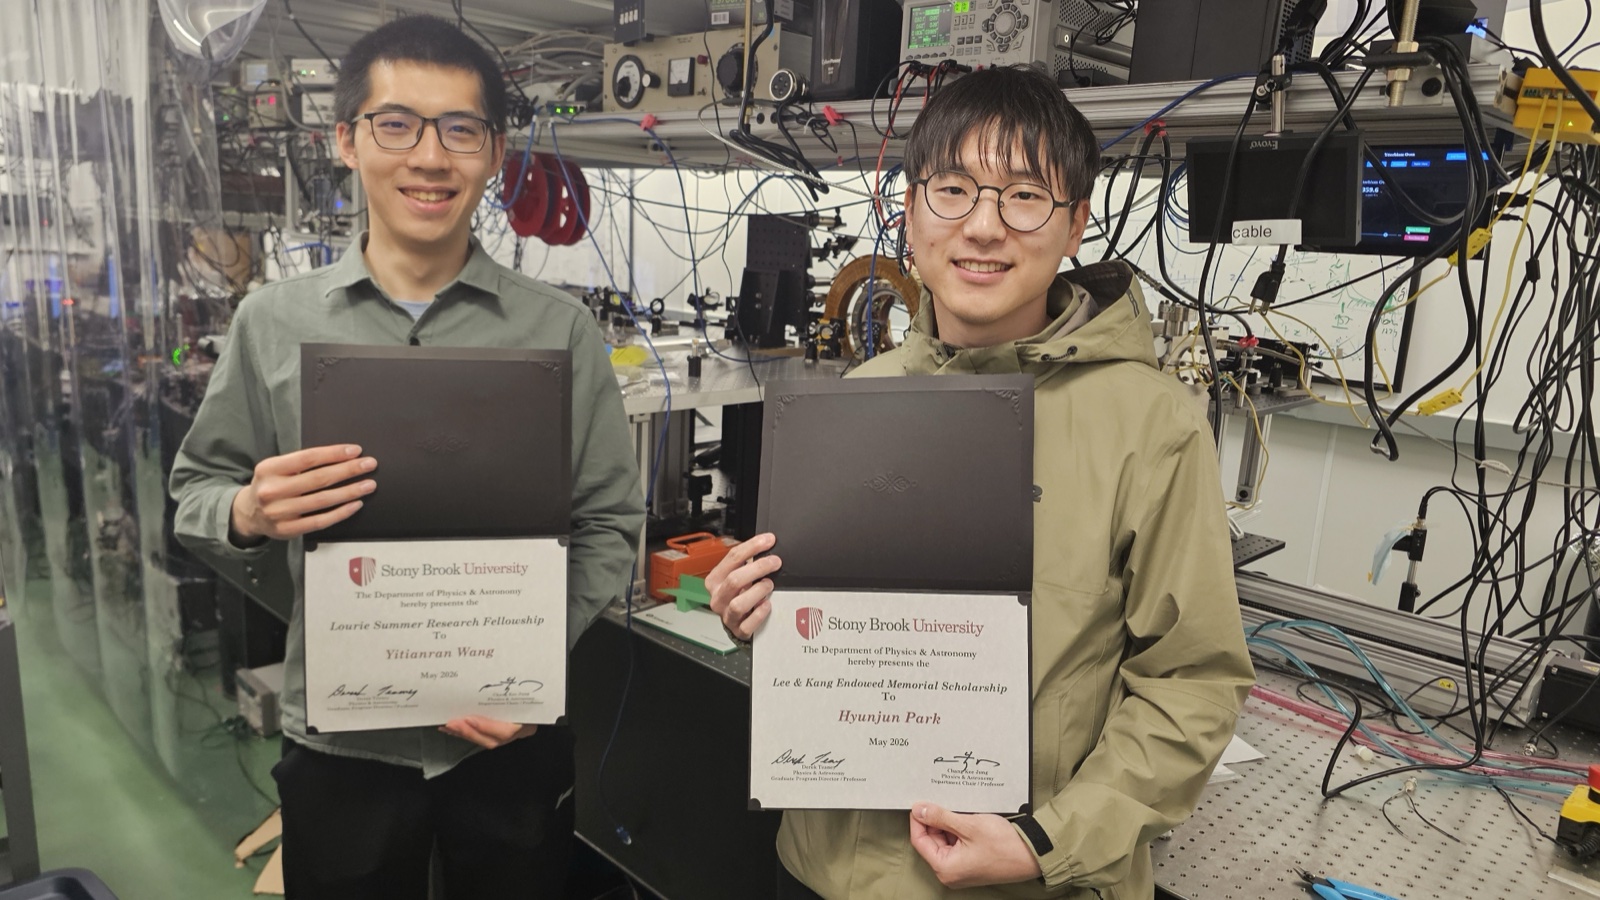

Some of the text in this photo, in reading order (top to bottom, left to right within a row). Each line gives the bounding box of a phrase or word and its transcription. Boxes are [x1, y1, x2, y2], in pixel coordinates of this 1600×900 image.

[1233, 225, 1272, 239] cable
[381, 562, 529, 579] Stony Brook University
[355, 591, 373, 599] The
[375, 590, 424, 599] Department
[426, 589, 434, 597] of
[436, 589, 468, 598] Physics
[479, 588, 522, 597] Astronomy
[400, 600, 428, 609] hereby
[430, 600, 464, 608] presents
[330, 615, 545, 631] Lourie Summer Research Fellowship
[828, 617, 984, 637] Stony Brook University
[432, 631, 447, 640] To
[385, 646, 495, 660] Yitianran Wang
[802, 645, 977, 660] The Department of Physics & Astronomy
[847, 658, 930, 668] hereby presents the
[420, 671, 458, 680] May 2026
[772, 678, 1008, 694] Lee & Kang Endowed Memorial Scholarship
[881, 692, 896, 701] To
[838, 709, 941, 725] Hyunjun Park
[868, 737, 909, 747] May 2026
